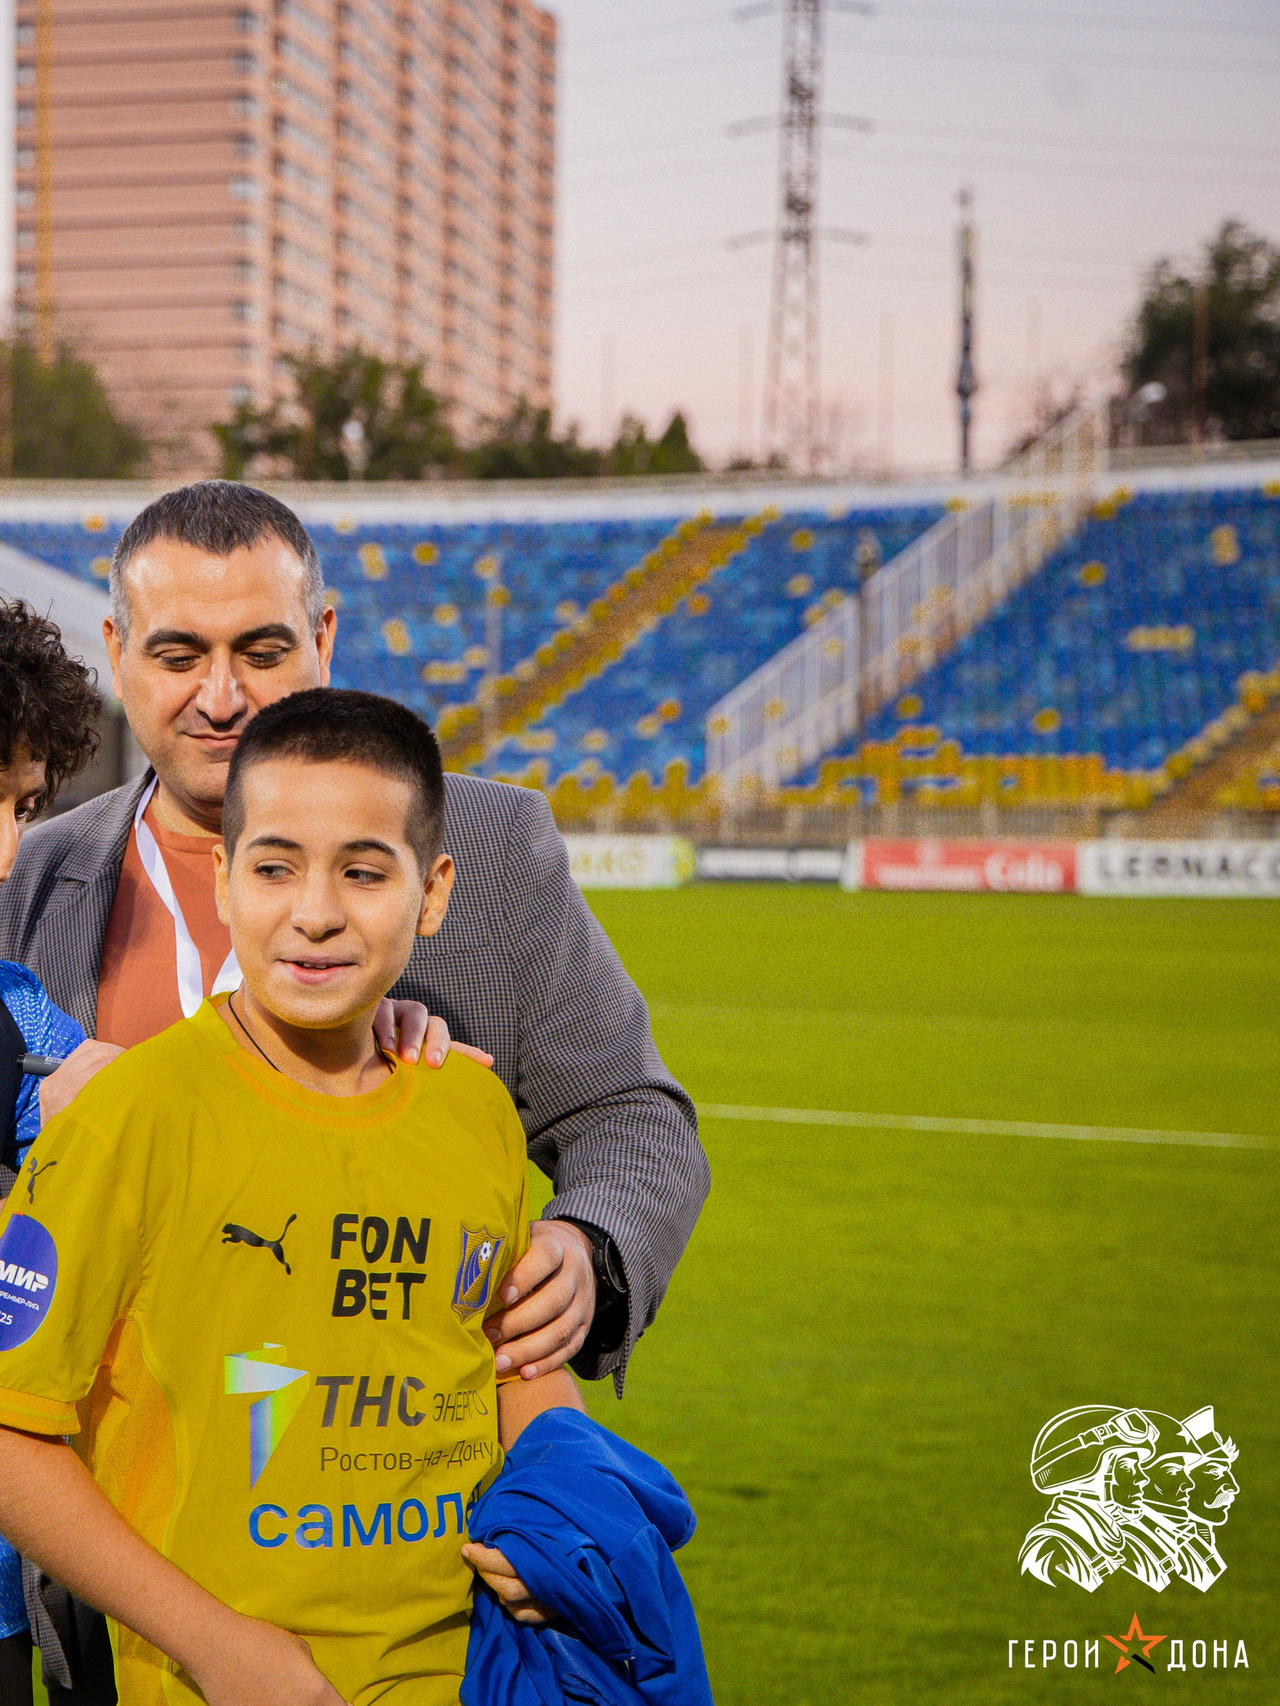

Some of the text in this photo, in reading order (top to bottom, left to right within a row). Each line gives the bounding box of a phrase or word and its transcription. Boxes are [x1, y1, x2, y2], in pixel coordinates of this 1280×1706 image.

[331, 1213, 431, 1264] FON
[332, 1269, 427, 1320] BET
[315, 1375, 489, 1428] ТНС ЭНЕРГО
[320, 1440, 494, 1472] Ростов-на-Дону
